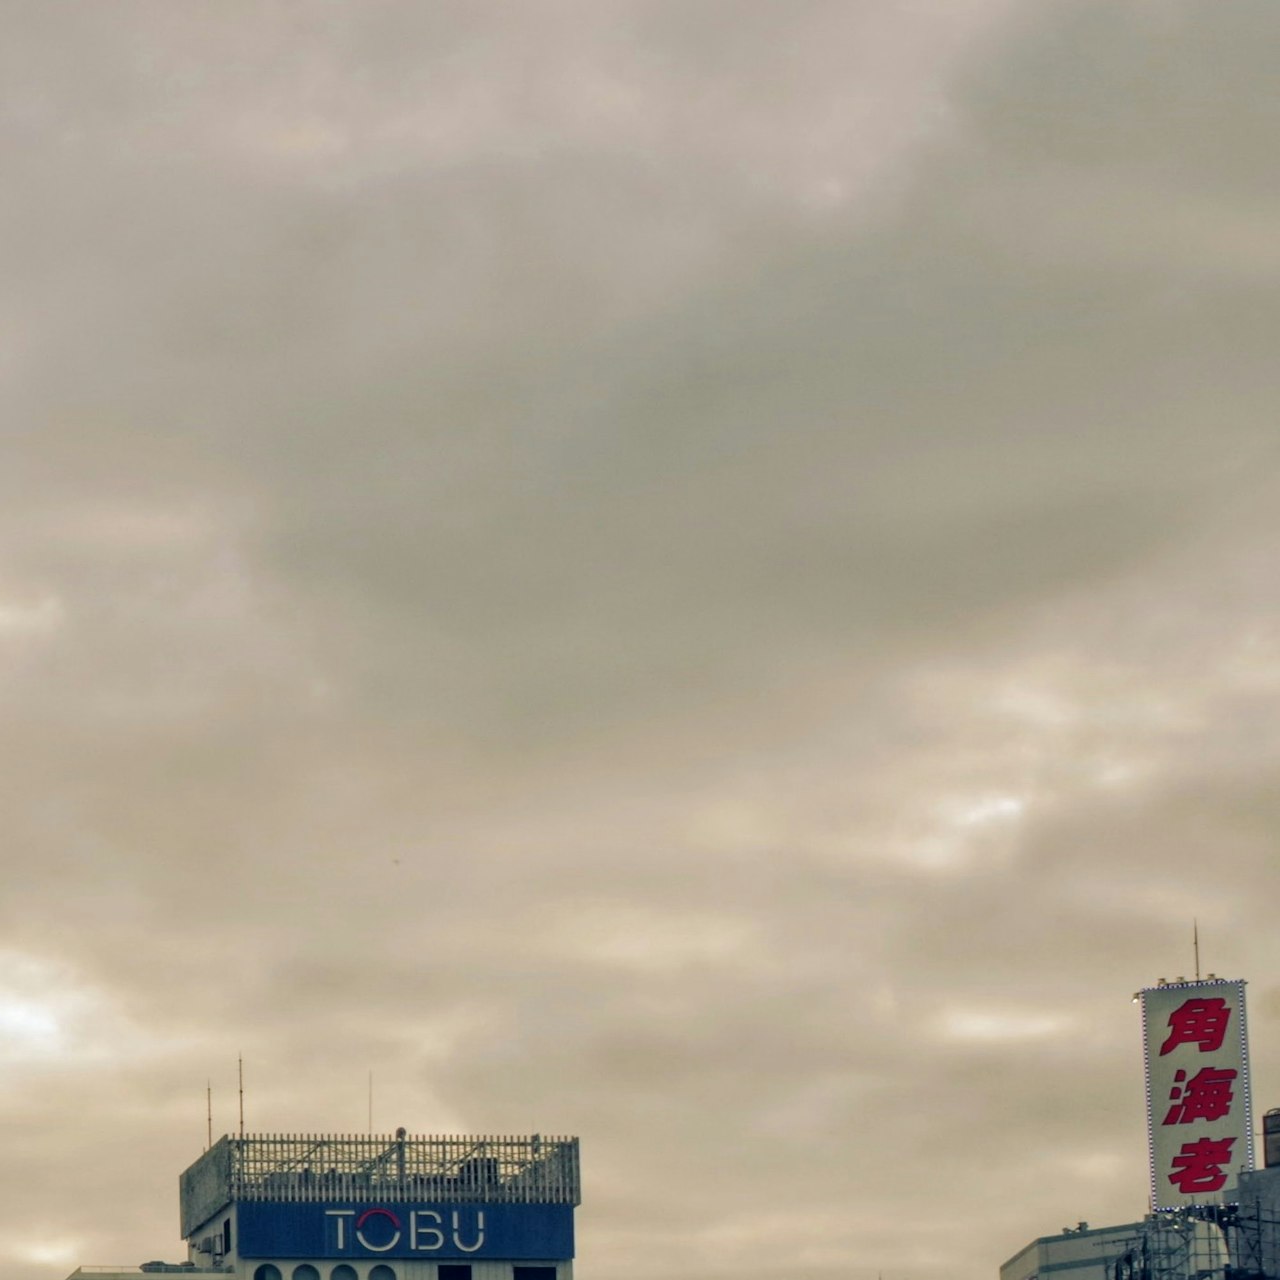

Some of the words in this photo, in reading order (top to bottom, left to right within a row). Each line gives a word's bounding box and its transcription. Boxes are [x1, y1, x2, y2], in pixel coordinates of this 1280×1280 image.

[1159, 997, 1238, 1194] 角海老
[325, 1208, 484, 1252] TOBU
